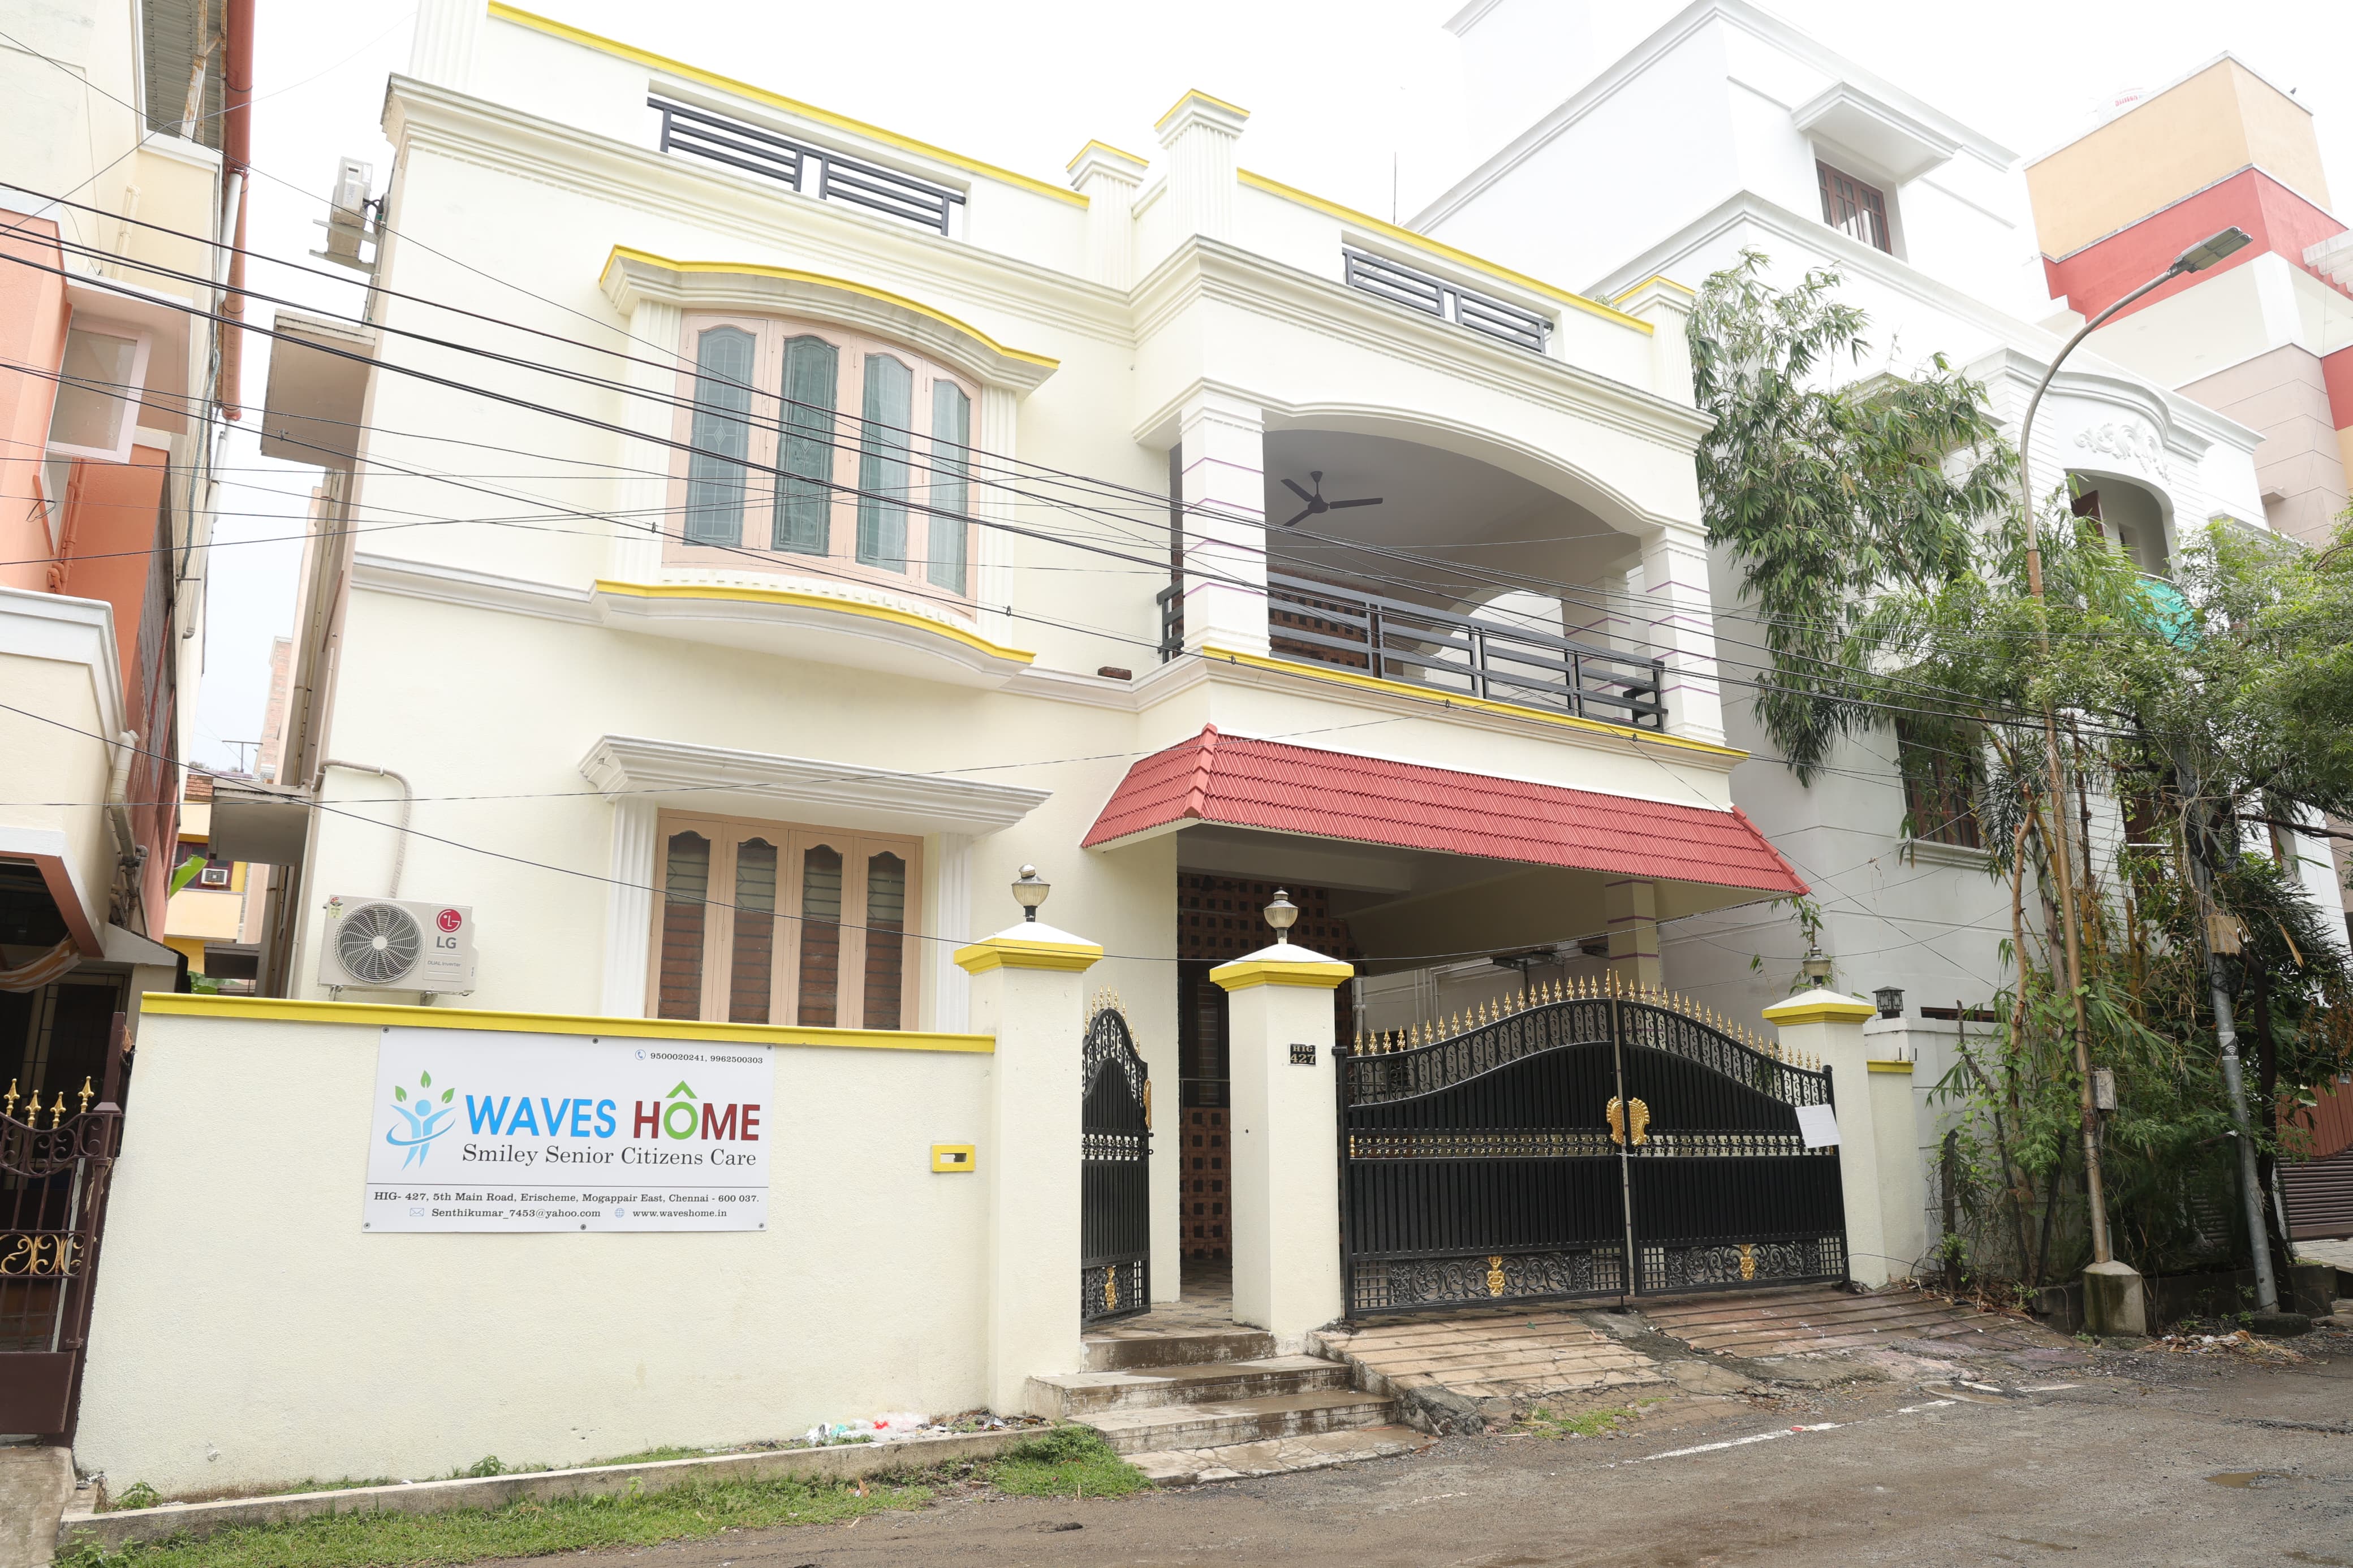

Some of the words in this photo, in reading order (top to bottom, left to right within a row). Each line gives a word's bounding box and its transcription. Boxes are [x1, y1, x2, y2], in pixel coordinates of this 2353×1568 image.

[436, 936, 457, 949] LG
[650, 1052, 708, 1062] 9500020241,
[710, 1055, 763, 1064] 9962500303
[1290, 1053, 1315, 1064] 427
[466, 1095, 617, 1138] WAVES
[634, 1100, 761, 1141] HOME
[463, 1143, 538, 1166] Smiley
[546, 1146, 614, 1164] Senior
[622, 1147, 703, 1165] Citizens
[710, 1148, 756, 1165] Care
[374, 1192, 401, 1200] HIG-
[404, 1193, 429, 1202] 427,
[433, 1193, 451, 1201] 5th
[486, 1193, 517, 1202] Road,
[520, 1193, 579, 1203] Erischeme,
[582, 1194, 637, 1203] Mogappair
[641, 1194, 666, 1203] East,
[669, 1194, 709, 1203] Chennai
[432, 1208, 601, 1219] Senthikumar_7453@yahoo.com
[632, 1209, 727, 1217] www.waveshome.in
